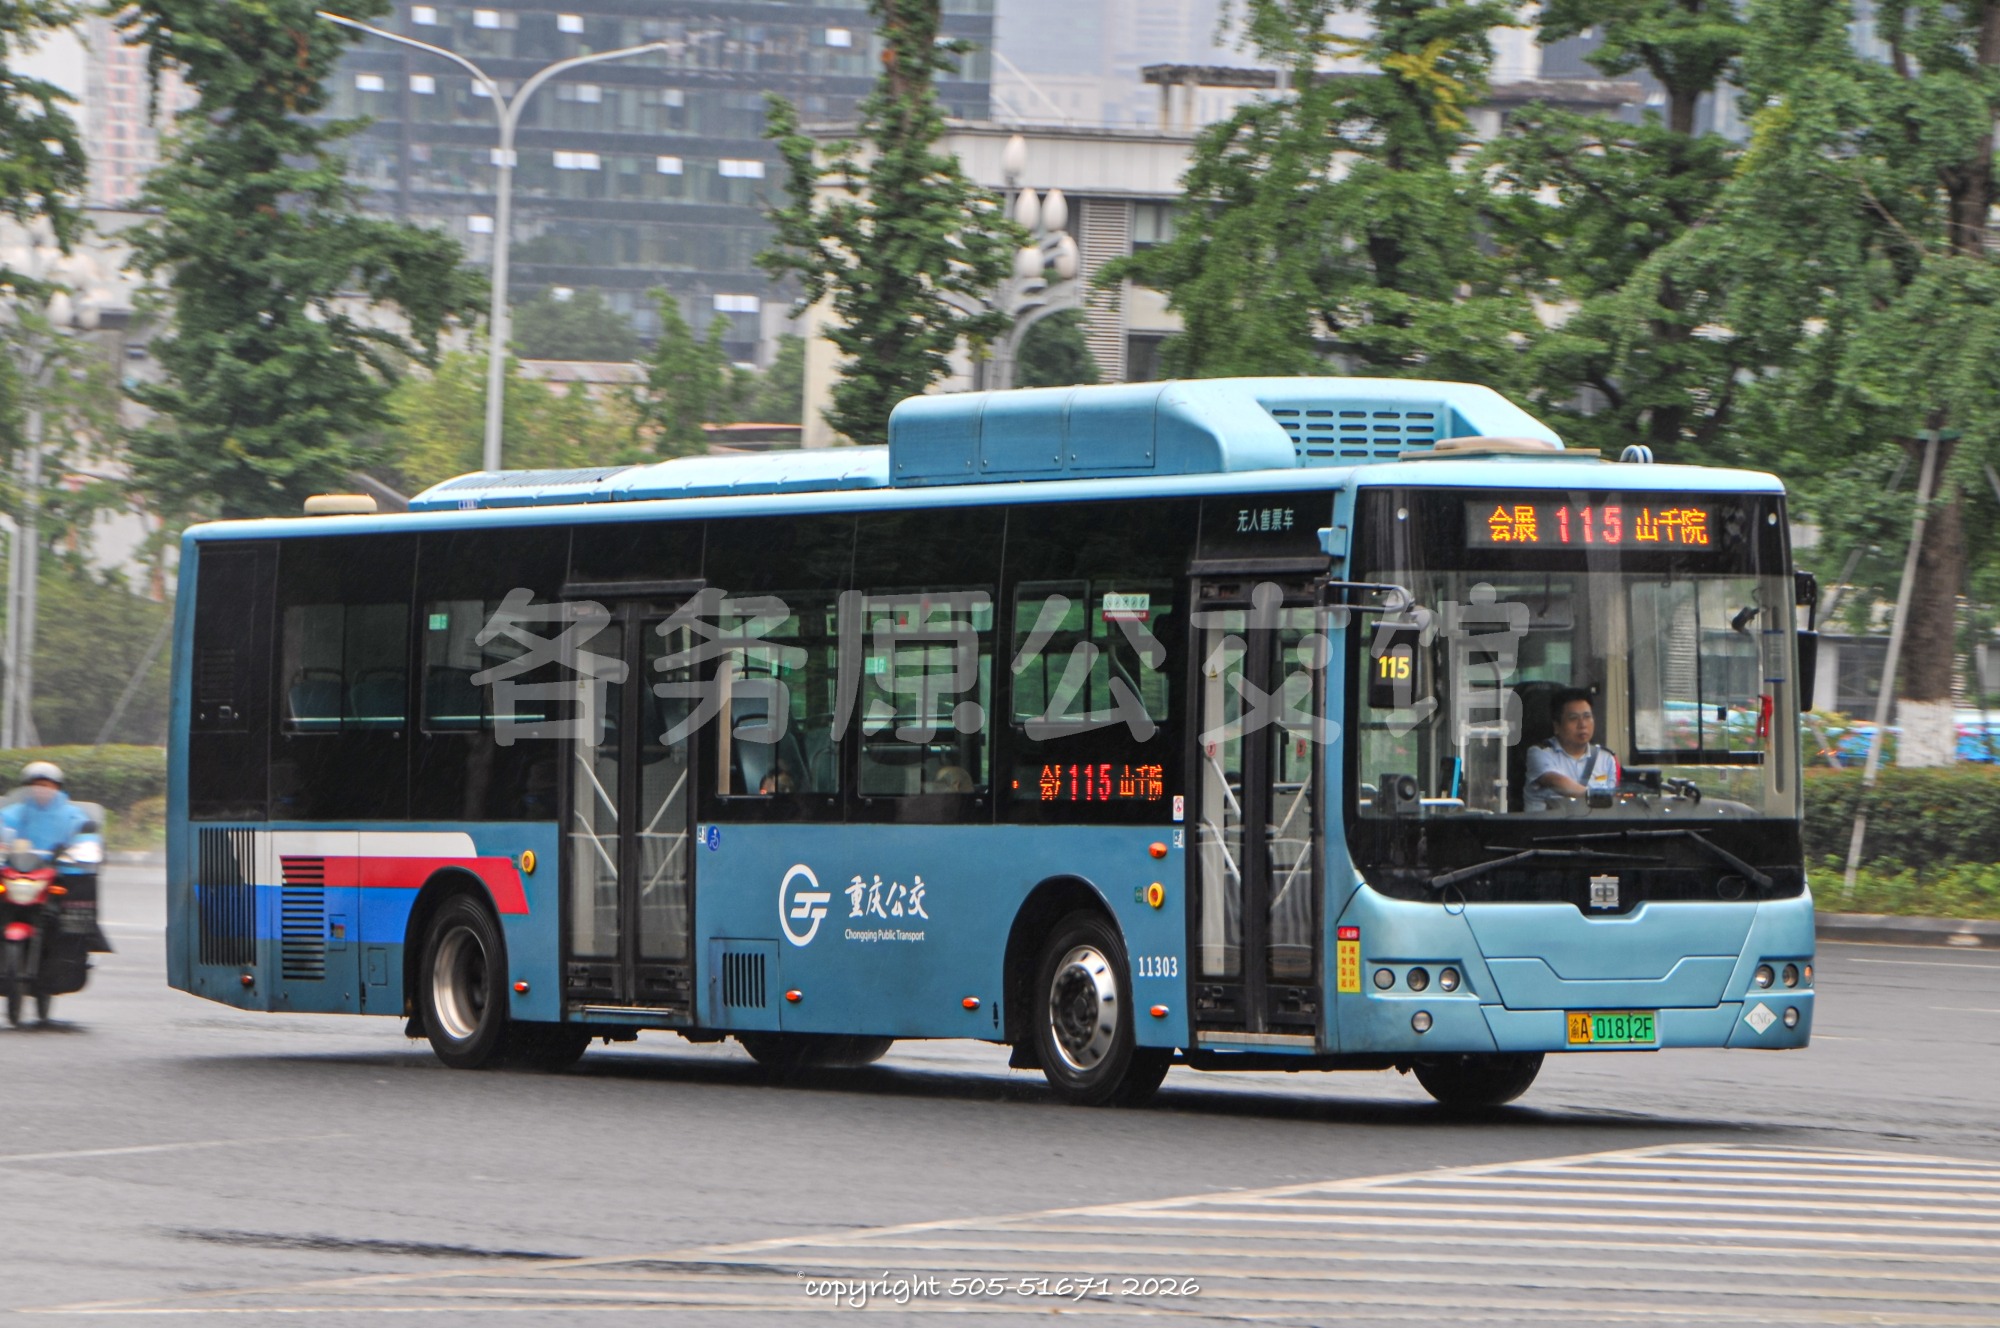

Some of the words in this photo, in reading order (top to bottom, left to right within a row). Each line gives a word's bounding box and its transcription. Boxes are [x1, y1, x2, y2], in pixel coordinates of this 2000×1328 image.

[1237, 507, 1294, 532] 无人售票车
[1488, 505, 1538, 542] 会展
[1556, 506, 1622, 543] 115
[1635, 508, 1709, 544] 山千院
[1378, 655, 1410, 679] 115
[1068, 764, 1113, 801] 115
[844, 874, 929, 919] 重庆公交
[844, 928, 878, 942] Chongqing
[878, 928, 896, 940] Public
[896, 929, 925, 942] Transport
[1138, 956, 1178, 977] 11303
[1750, 1012, 1771, 1025] CNG
